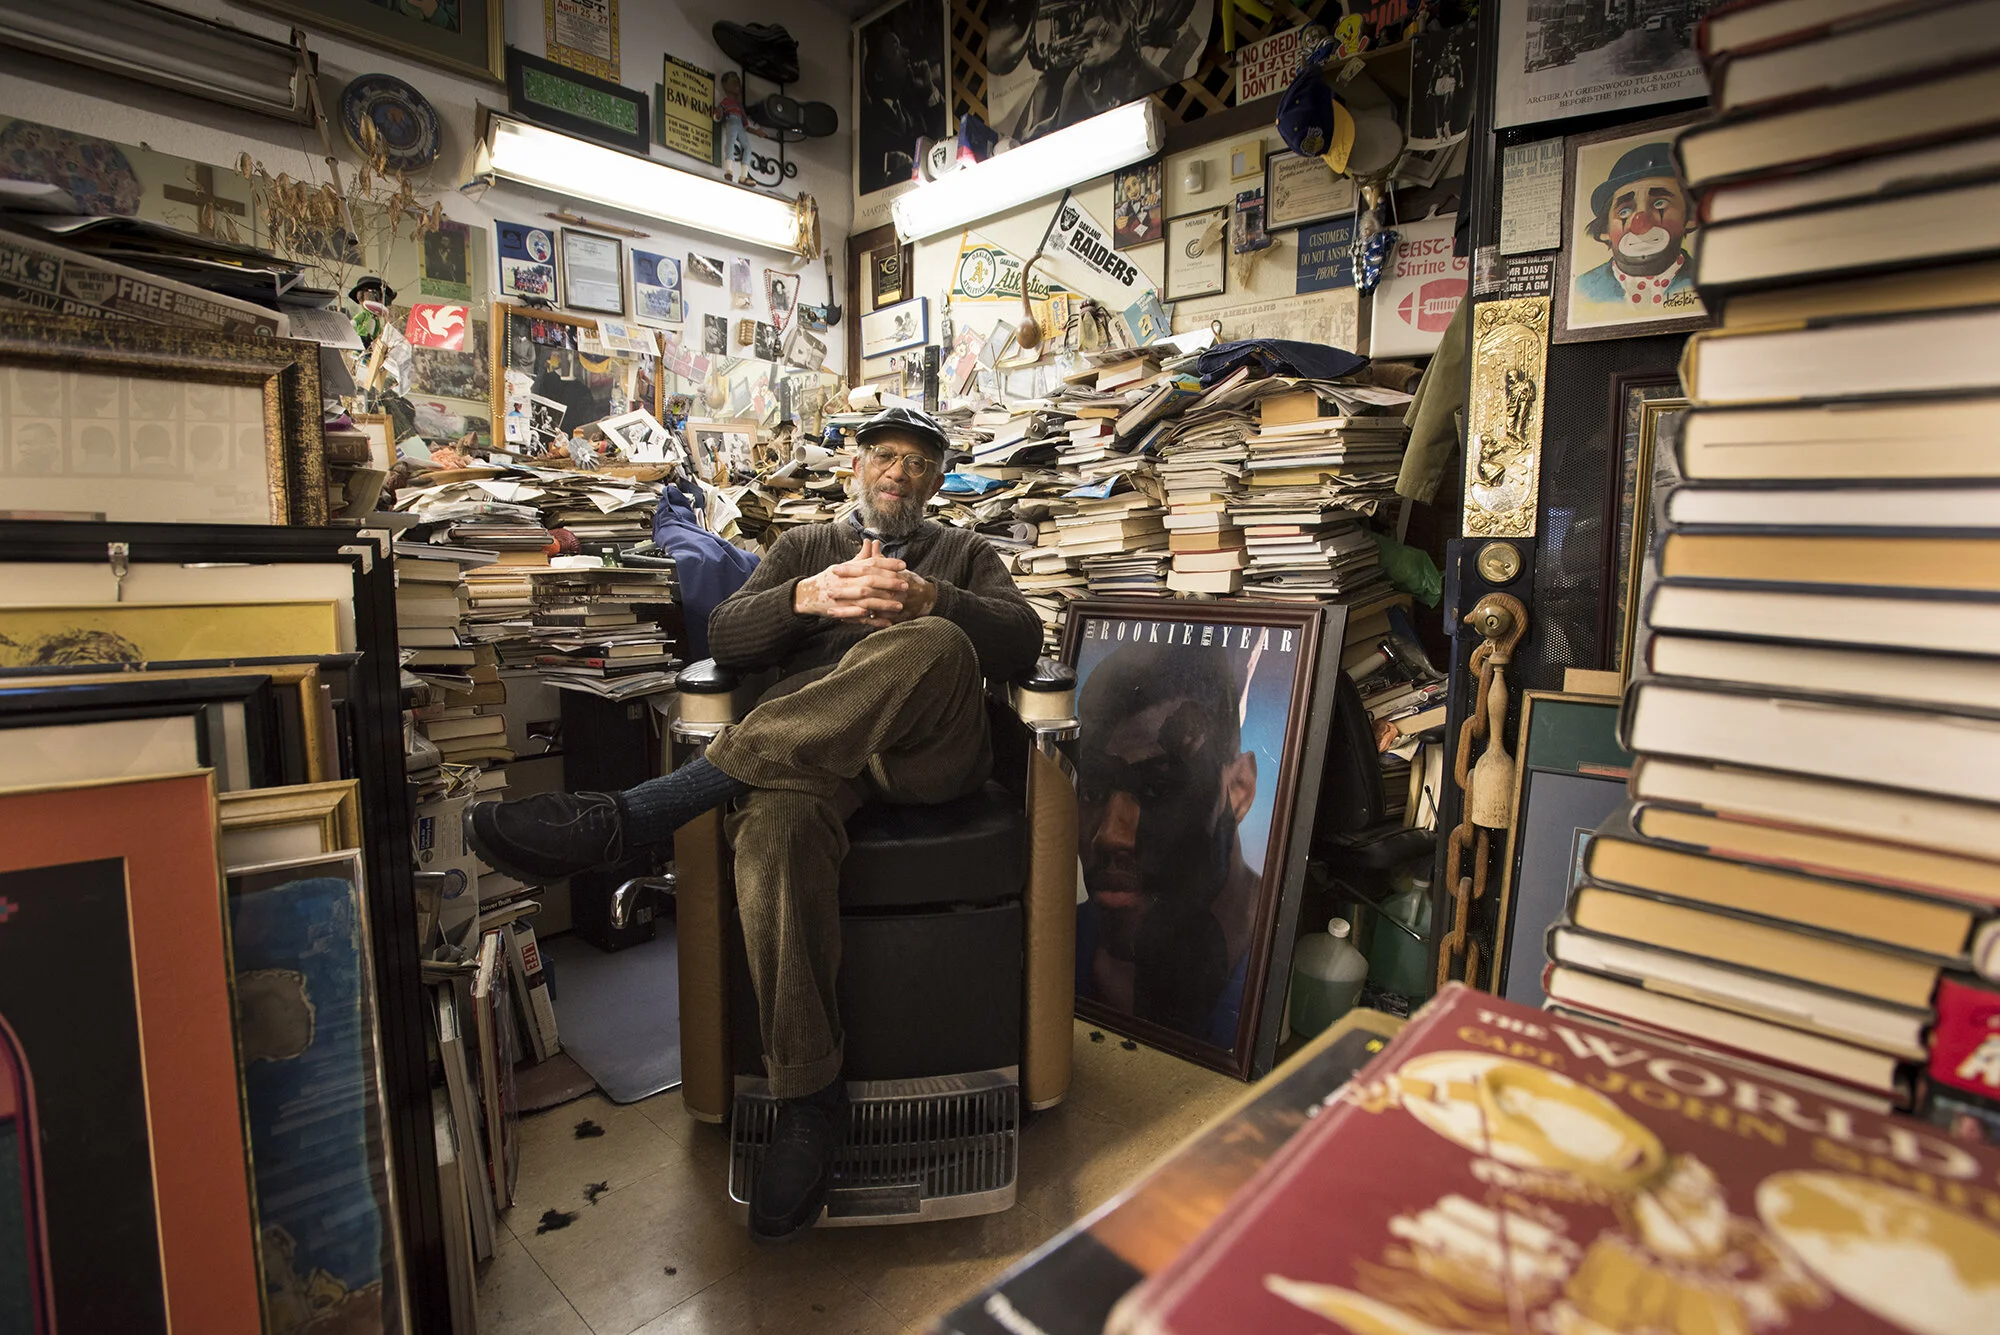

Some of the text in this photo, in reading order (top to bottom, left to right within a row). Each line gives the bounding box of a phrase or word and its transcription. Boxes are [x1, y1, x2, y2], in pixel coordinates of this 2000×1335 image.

[557, 1, 578, 14] April
[580, 6, 591, 19] 25
[598, 14, 608, 25] 27
[1242, 30, 1301, 67] NO CREDI
[1242, 74, 1277, 100] DON'T
[1526, 93, 1561, 105] ARCHER
[1562, 89, 1574, 99] AT
[1575, 79, 1633, 96] GREENWOOD
[1594, 92, 1612, 102] THE
[1614, 89, 1632, 99] 1921
[1634, 84, 1659, 95] RACE
[1660, 81, 1682, 91] RIOT
[666, 87, 713, 118] BAY RUM
[1517, 146, 1538, 166] KLUX
[1540, 142, 1563, 160] KLAN
[1078, 221, 1102, 241] OAKLAND
[1309, 227, 1350, 248] CUSTOMERS
[971, 251, 993, 266] OAKLAND
[1000, 258, 1020, 268] OAKLAND
[1069, 228, 1138, 287] RAIDERS
[1301, 253, 1311, 266] DO
[1311, 249, 1326, 264] NOT
[1397, 260, 1446, 278] Shrine
[1452, 256, 1469, 271] G
[1315, 264, 1341, 281] PHONE
[1523, 265, 1549, 275] DAVIS
[118, 277, 174, 312] FREE
[962, 280, 987, 294] ATHLETICS
[994, 268, 1050, 297] Athetics
[1525, 281, 1532, 291] A
[1534, 280, 1549, 290] GM
[17, 287, 59, 312] 2017
[175, 294, 206, 311] GLOVE
[207, 302, 257, 325] STEAMING
[173, 305, 226, 325] AVAILABLE
[1100, 620, 1194, 646] ROOKIE
[1221, 625, 1293, 652] YEAR
[522, 942, 539, 971] LIFE
[1476, 1008, 1981, 1179] THE WORLD
[1585, 1071, 1787, 1148] JOHN
